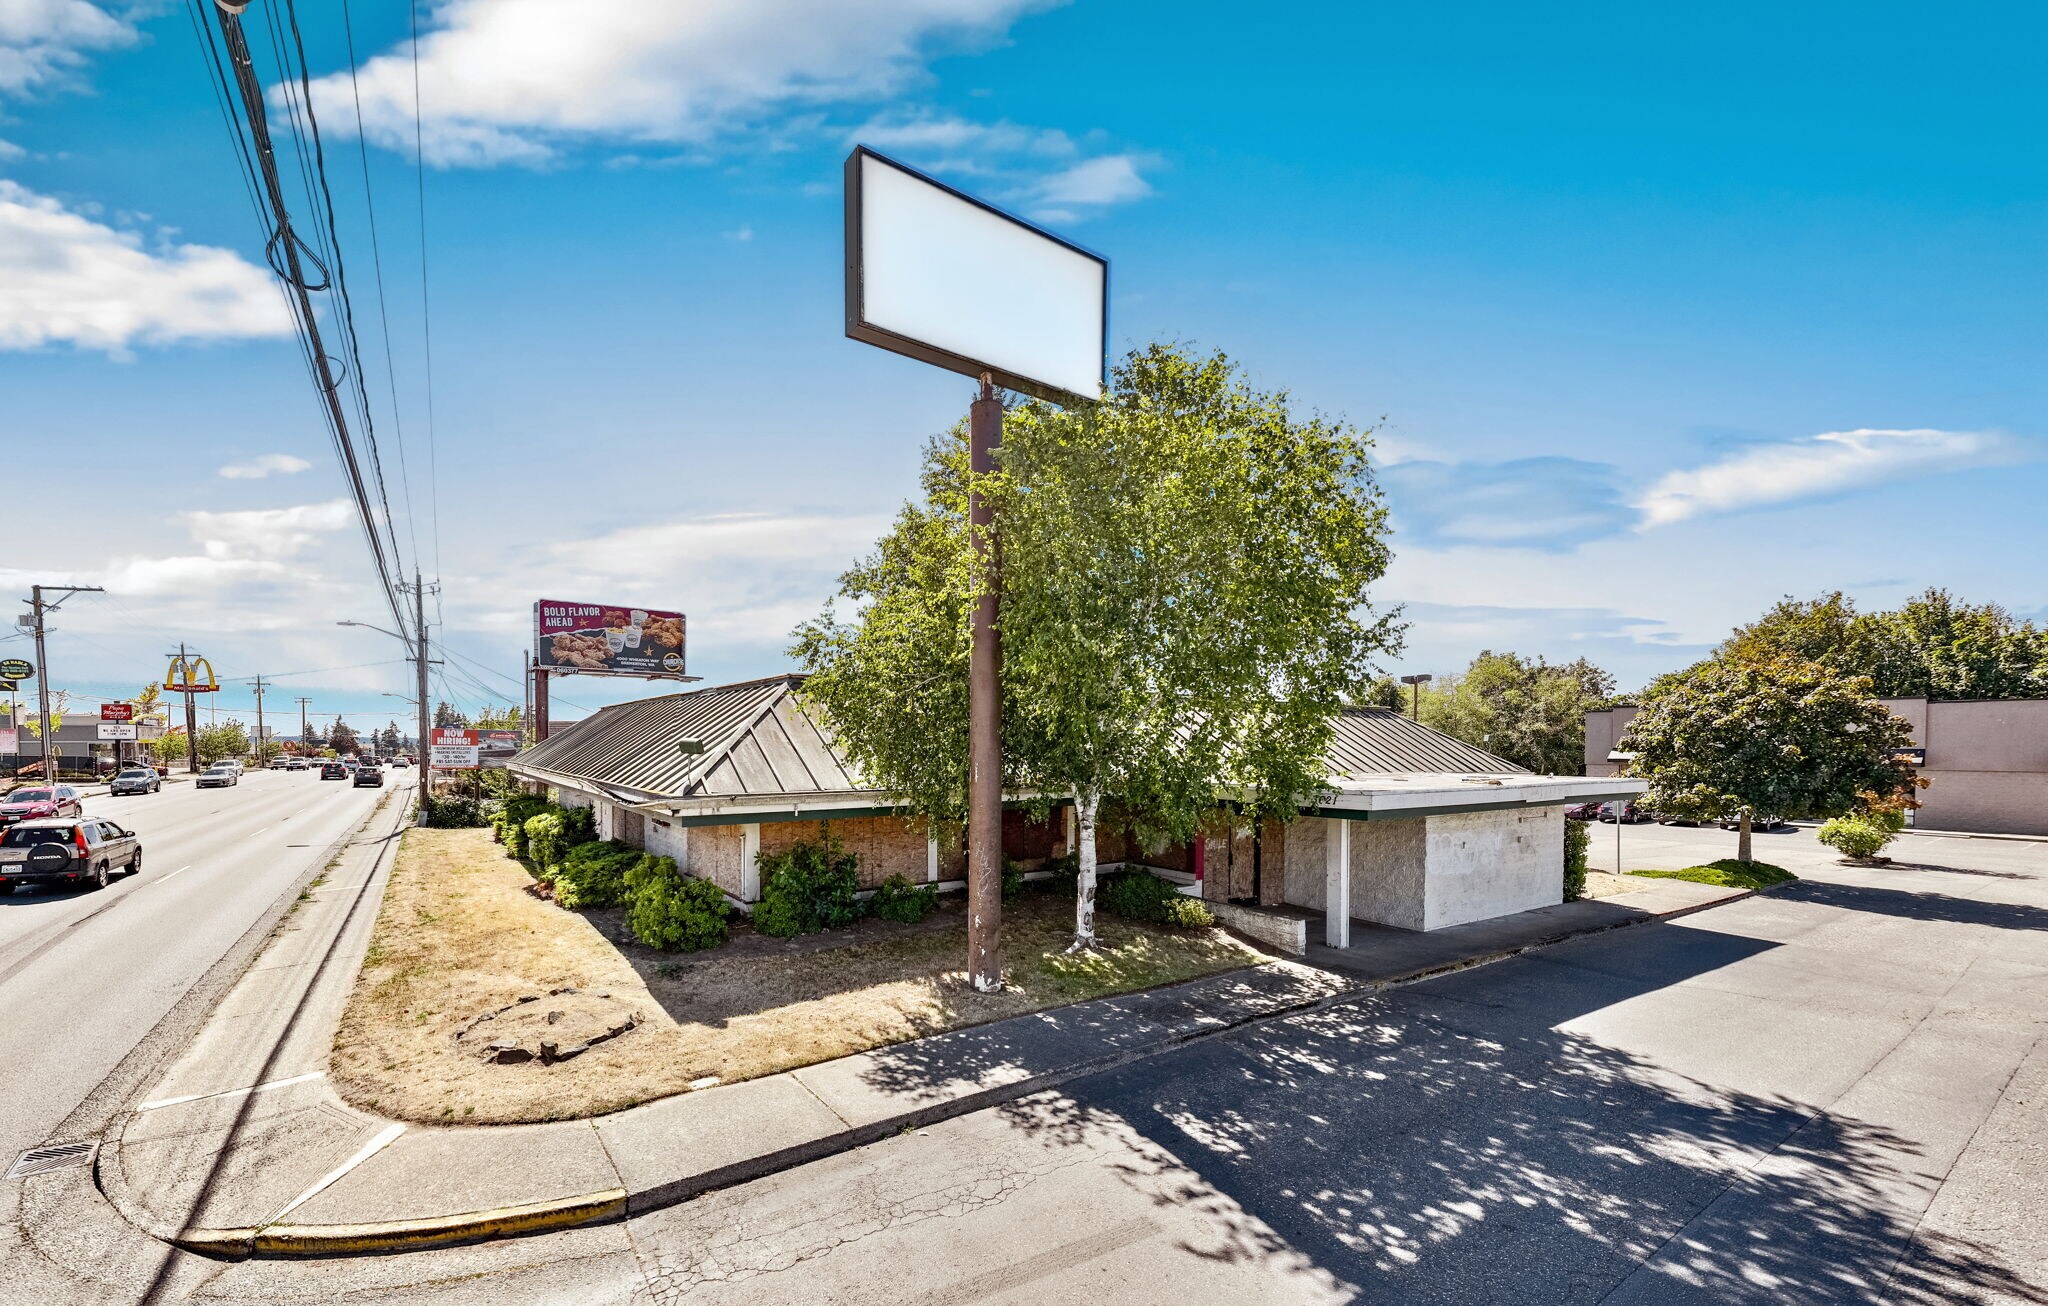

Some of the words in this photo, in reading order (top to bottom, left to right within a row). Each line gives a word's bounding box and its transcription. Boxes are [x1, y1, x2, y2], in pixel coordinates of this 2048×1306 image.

[544, 607, 566, 617] BOLD
[568, 607, 601, 617] FLAVOR
[545, 617, 573, 627] AHEAD
[443, 729, 465, 738] NOW
[437, 737, 471, 745] HIRING!
